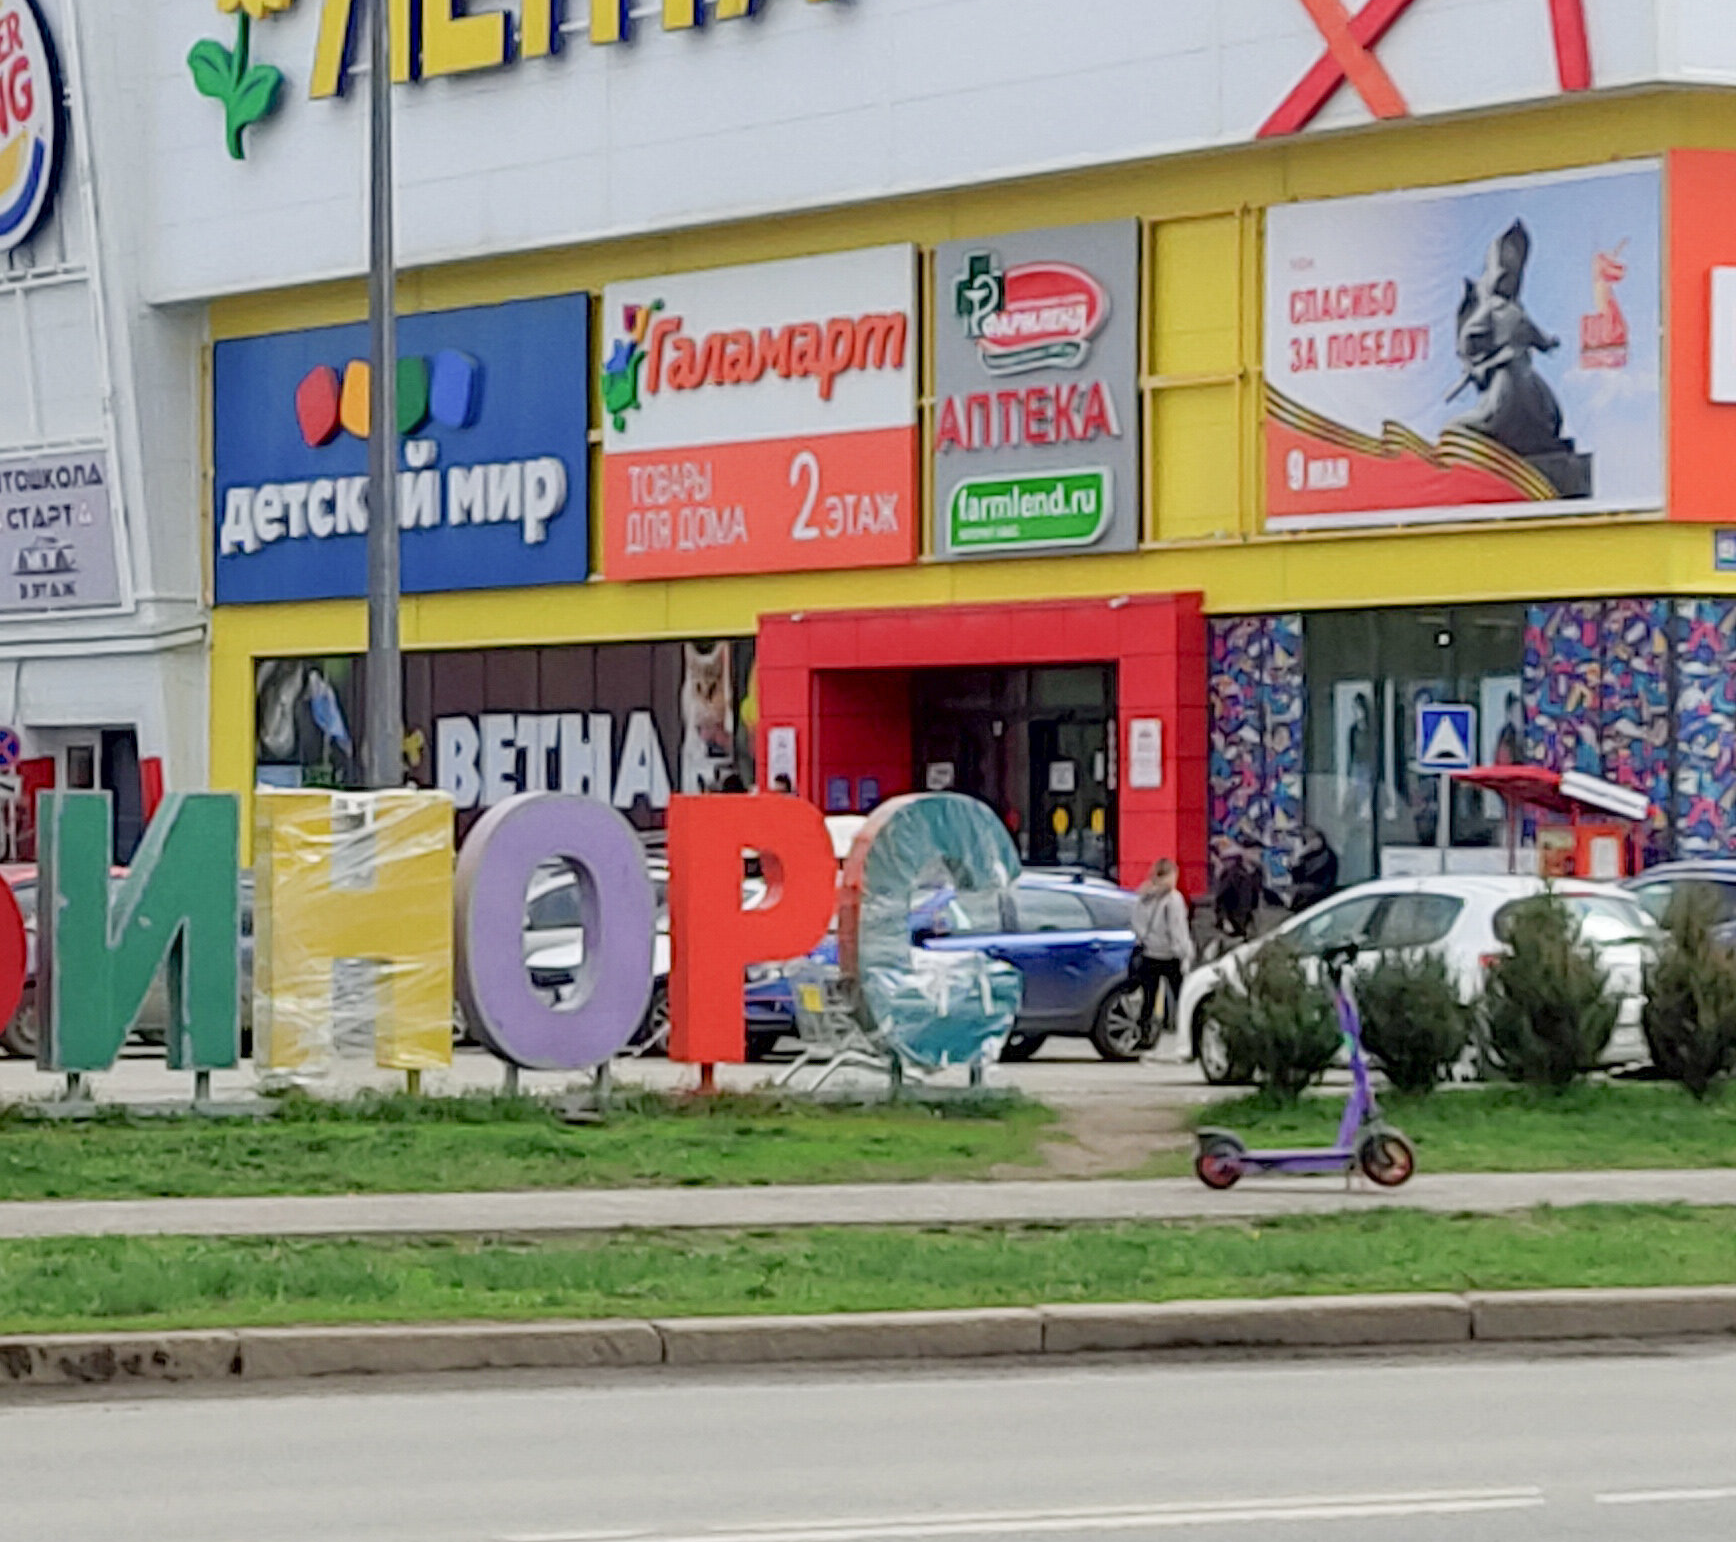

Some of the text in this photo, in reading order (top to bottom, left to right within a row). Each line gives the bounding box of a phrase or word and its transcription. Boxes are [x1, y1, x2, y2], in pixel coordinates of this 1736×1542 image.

[1289, 280, 1398, 326] СПАСИБО
[647, 312, 907, 401] Галамарт
[1289, 325, 1430, 373] ЗА ПОБЕДУ!
[935, 380, 1124, 454] АПТЕКА
[628, 462, 713, 505] ТОВАРЫ
[1287, 449, 1305, 491] 9
[6, 504, 72, 530] СТАРТ
[220, 439, 568, 556] детскй мир
[789, 450, 900, 540] 2 ЭТАЖ
[958, 482, 1098, 523] farmlend.ru
[625, 505, 748, 556] ДЛЯ ДОМА
[37, 788, 1023, 1071] ИНОРС
